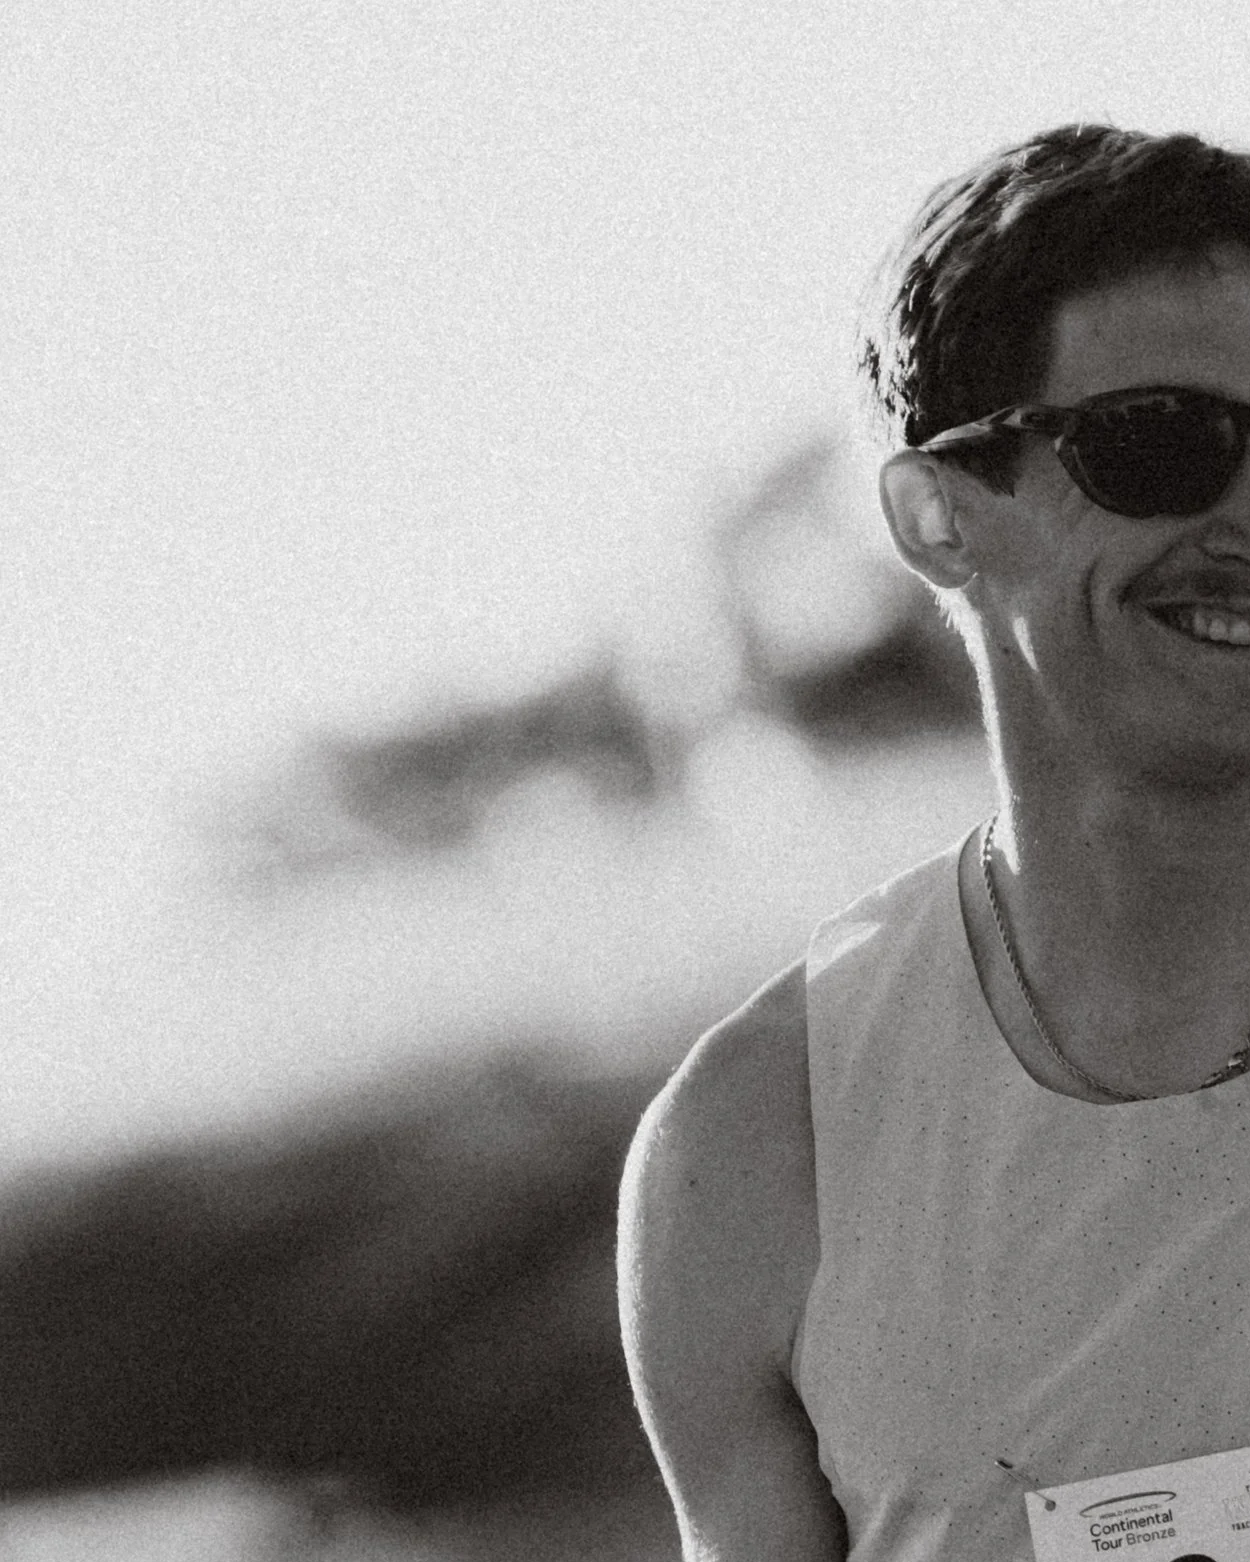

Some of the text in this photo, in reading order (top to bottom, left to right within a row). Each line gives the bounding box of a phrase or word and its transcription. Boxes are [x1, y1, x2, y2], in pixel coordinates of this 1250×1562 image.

[1090, 1508, 1174, 1537] Continental
[1091, 1527, 1176, 1552] Tour Bronze
